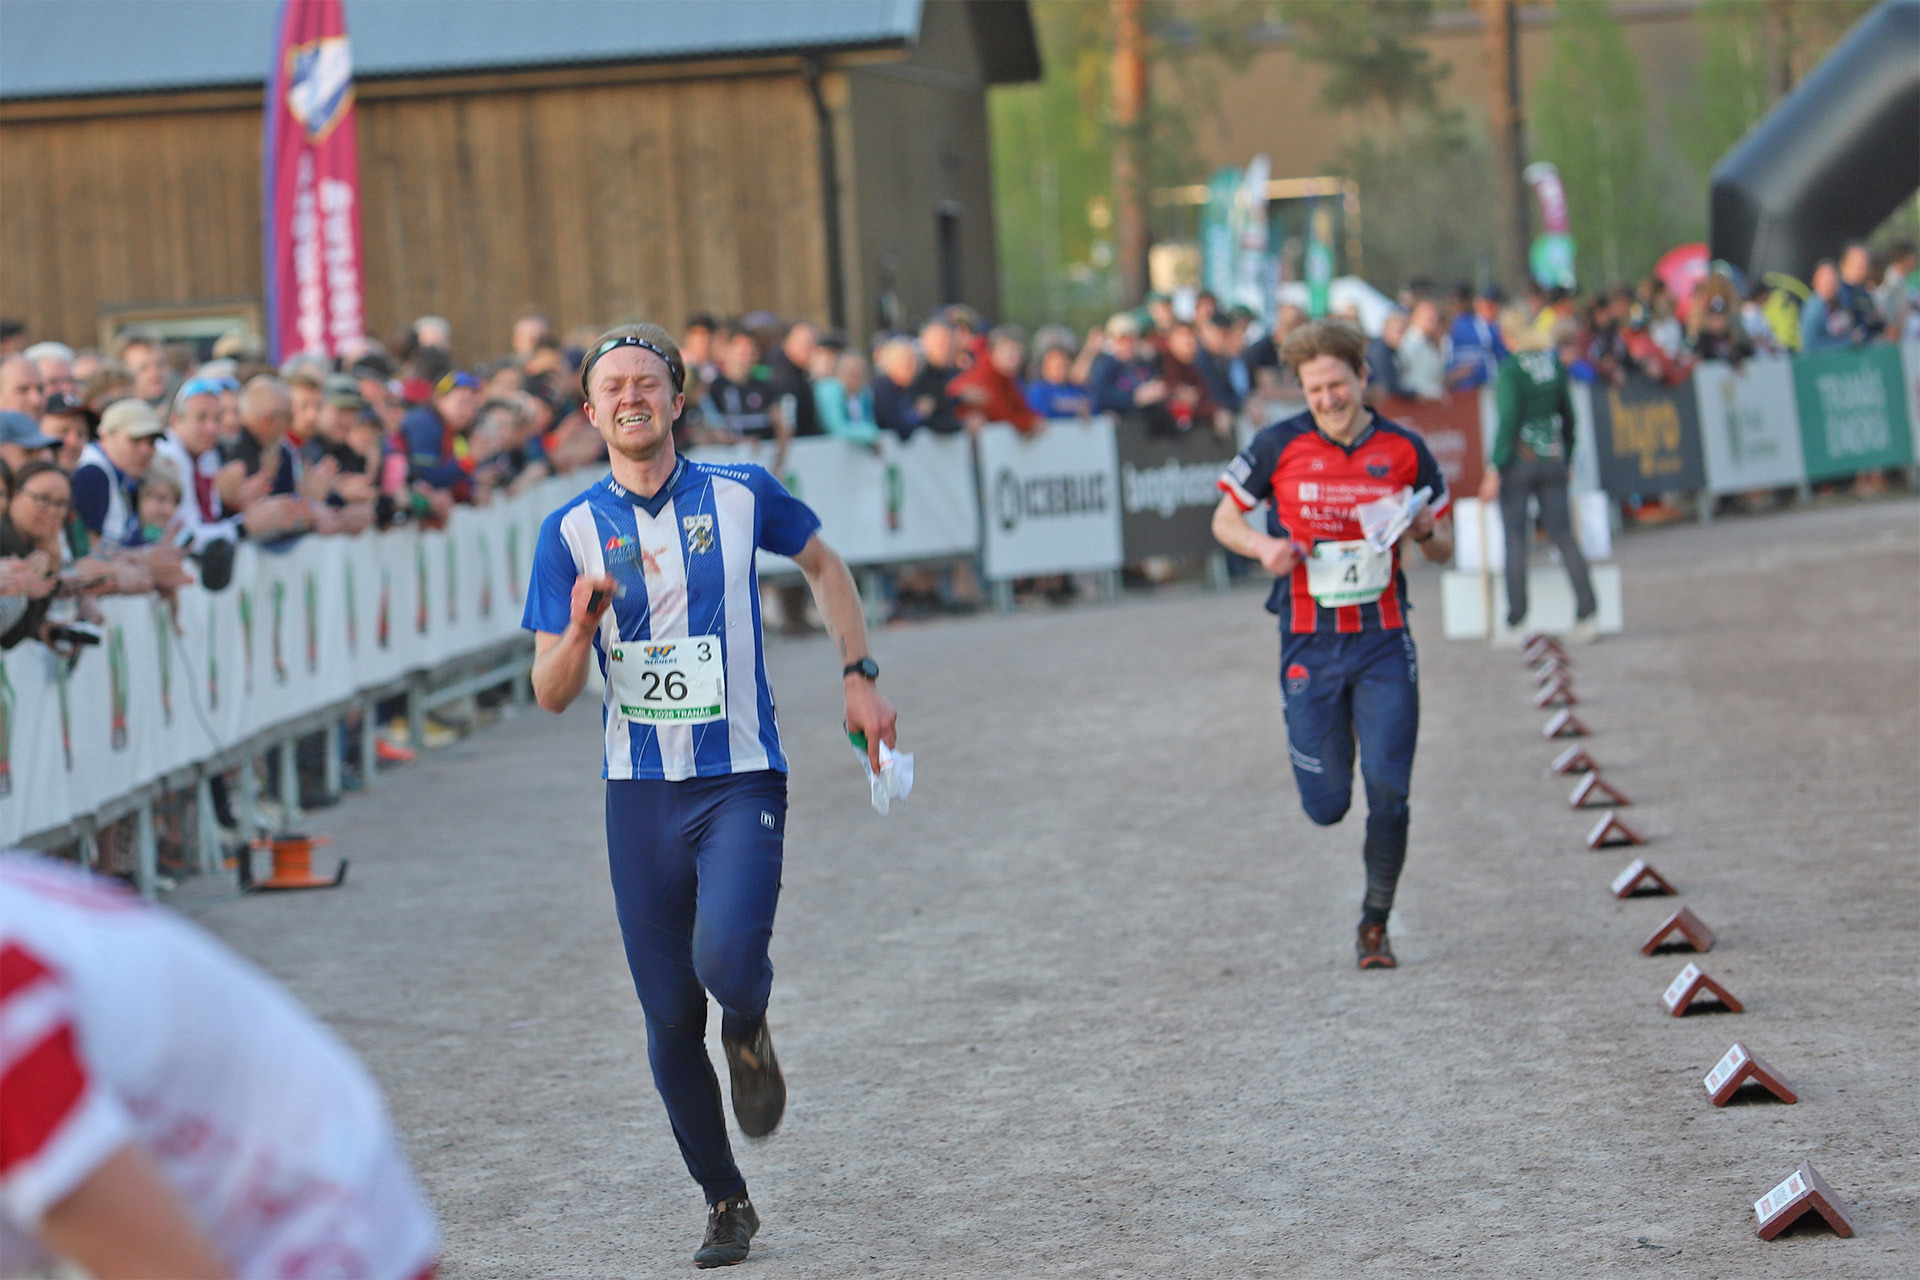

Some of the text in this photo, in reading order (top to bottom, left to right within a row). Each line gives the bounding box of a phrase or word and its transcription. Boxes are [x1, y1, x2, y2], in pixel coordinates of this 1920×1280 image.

[1343, 564, 1358, 585] 4
[697, 642, 712, 662] 3
[641, 671, 688, 701] 26
